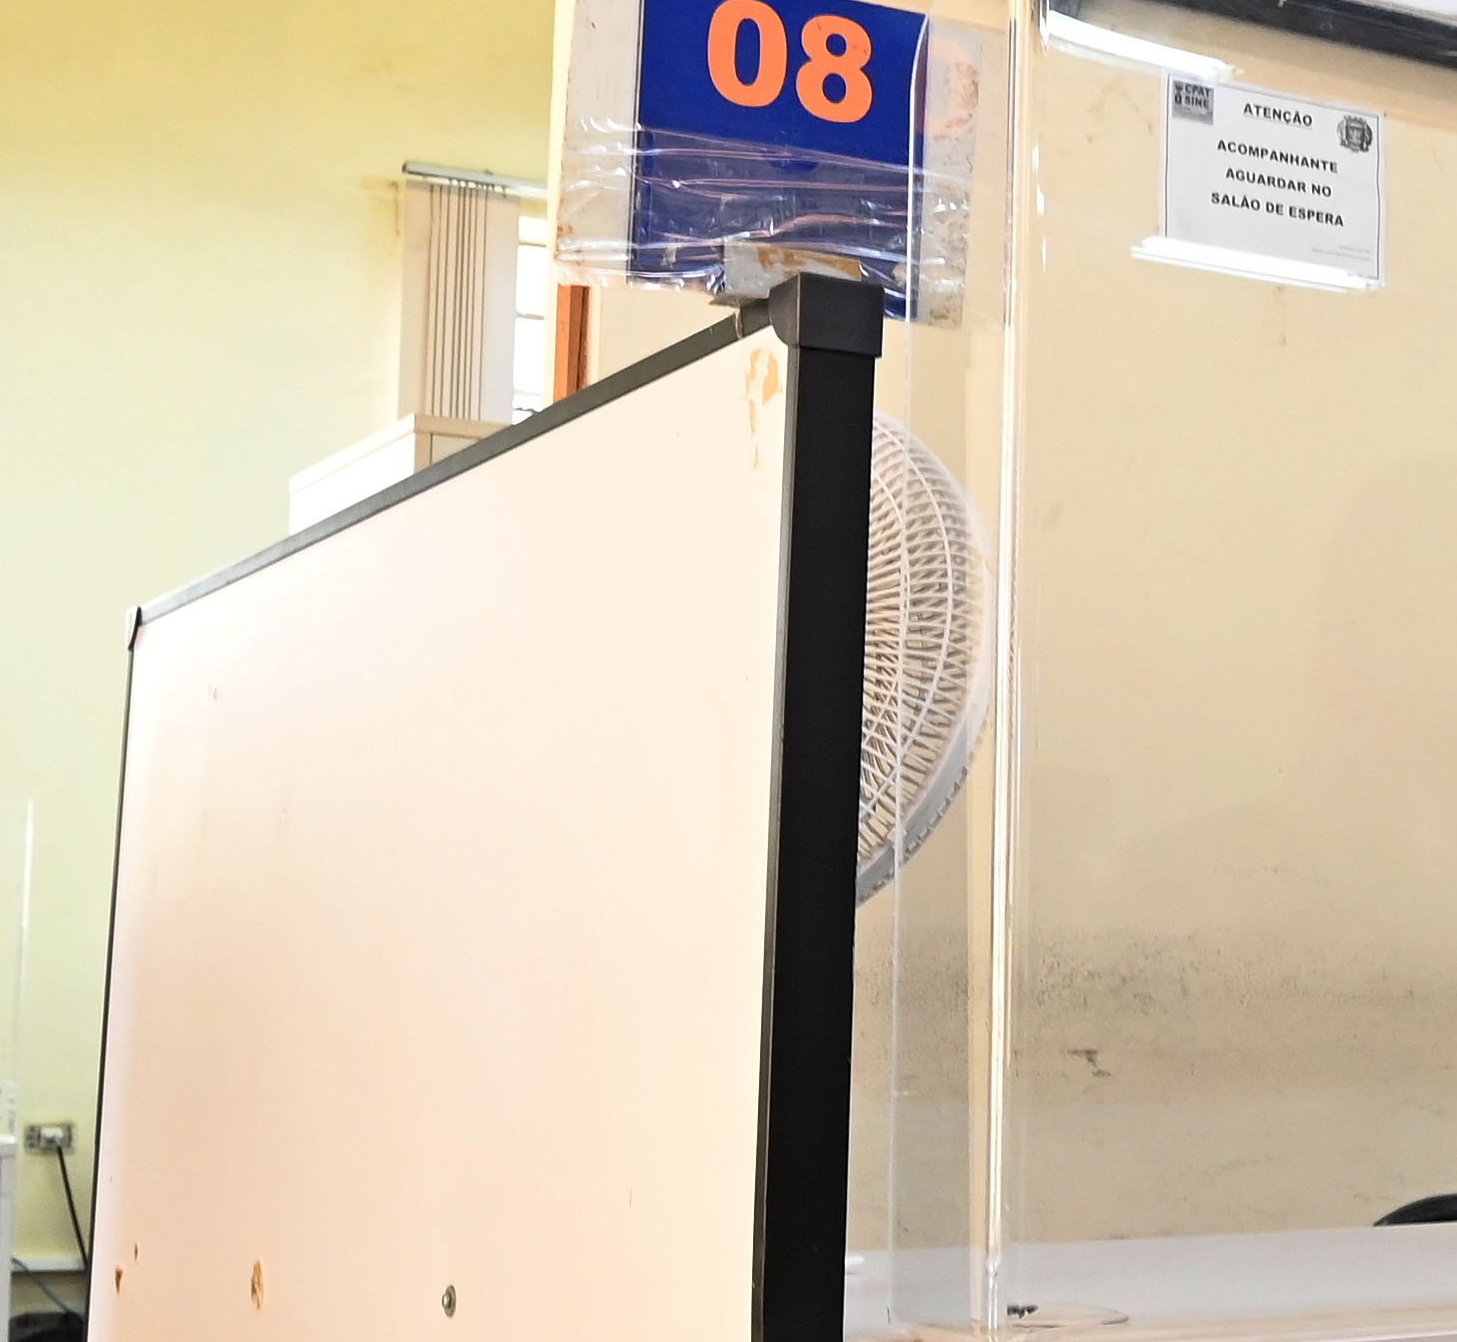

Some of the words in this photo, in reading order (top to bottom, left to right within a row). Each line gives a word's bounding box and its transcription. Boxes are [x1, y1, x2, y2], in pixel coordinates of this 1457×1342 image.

[1243, 102, 1313, 128] ATENÇÃO
[1217, 139, 1339, 174] ACOMPANHANTE
[1225, 167, 1307, 194] AGUARDAR
[1311, 183, 1333, 198] NO
[1210, 191, 1261, 212] SALÃO
[1265, 201, 1285, 216] DE
[1288, 206, 1345, 227] ESPERA
